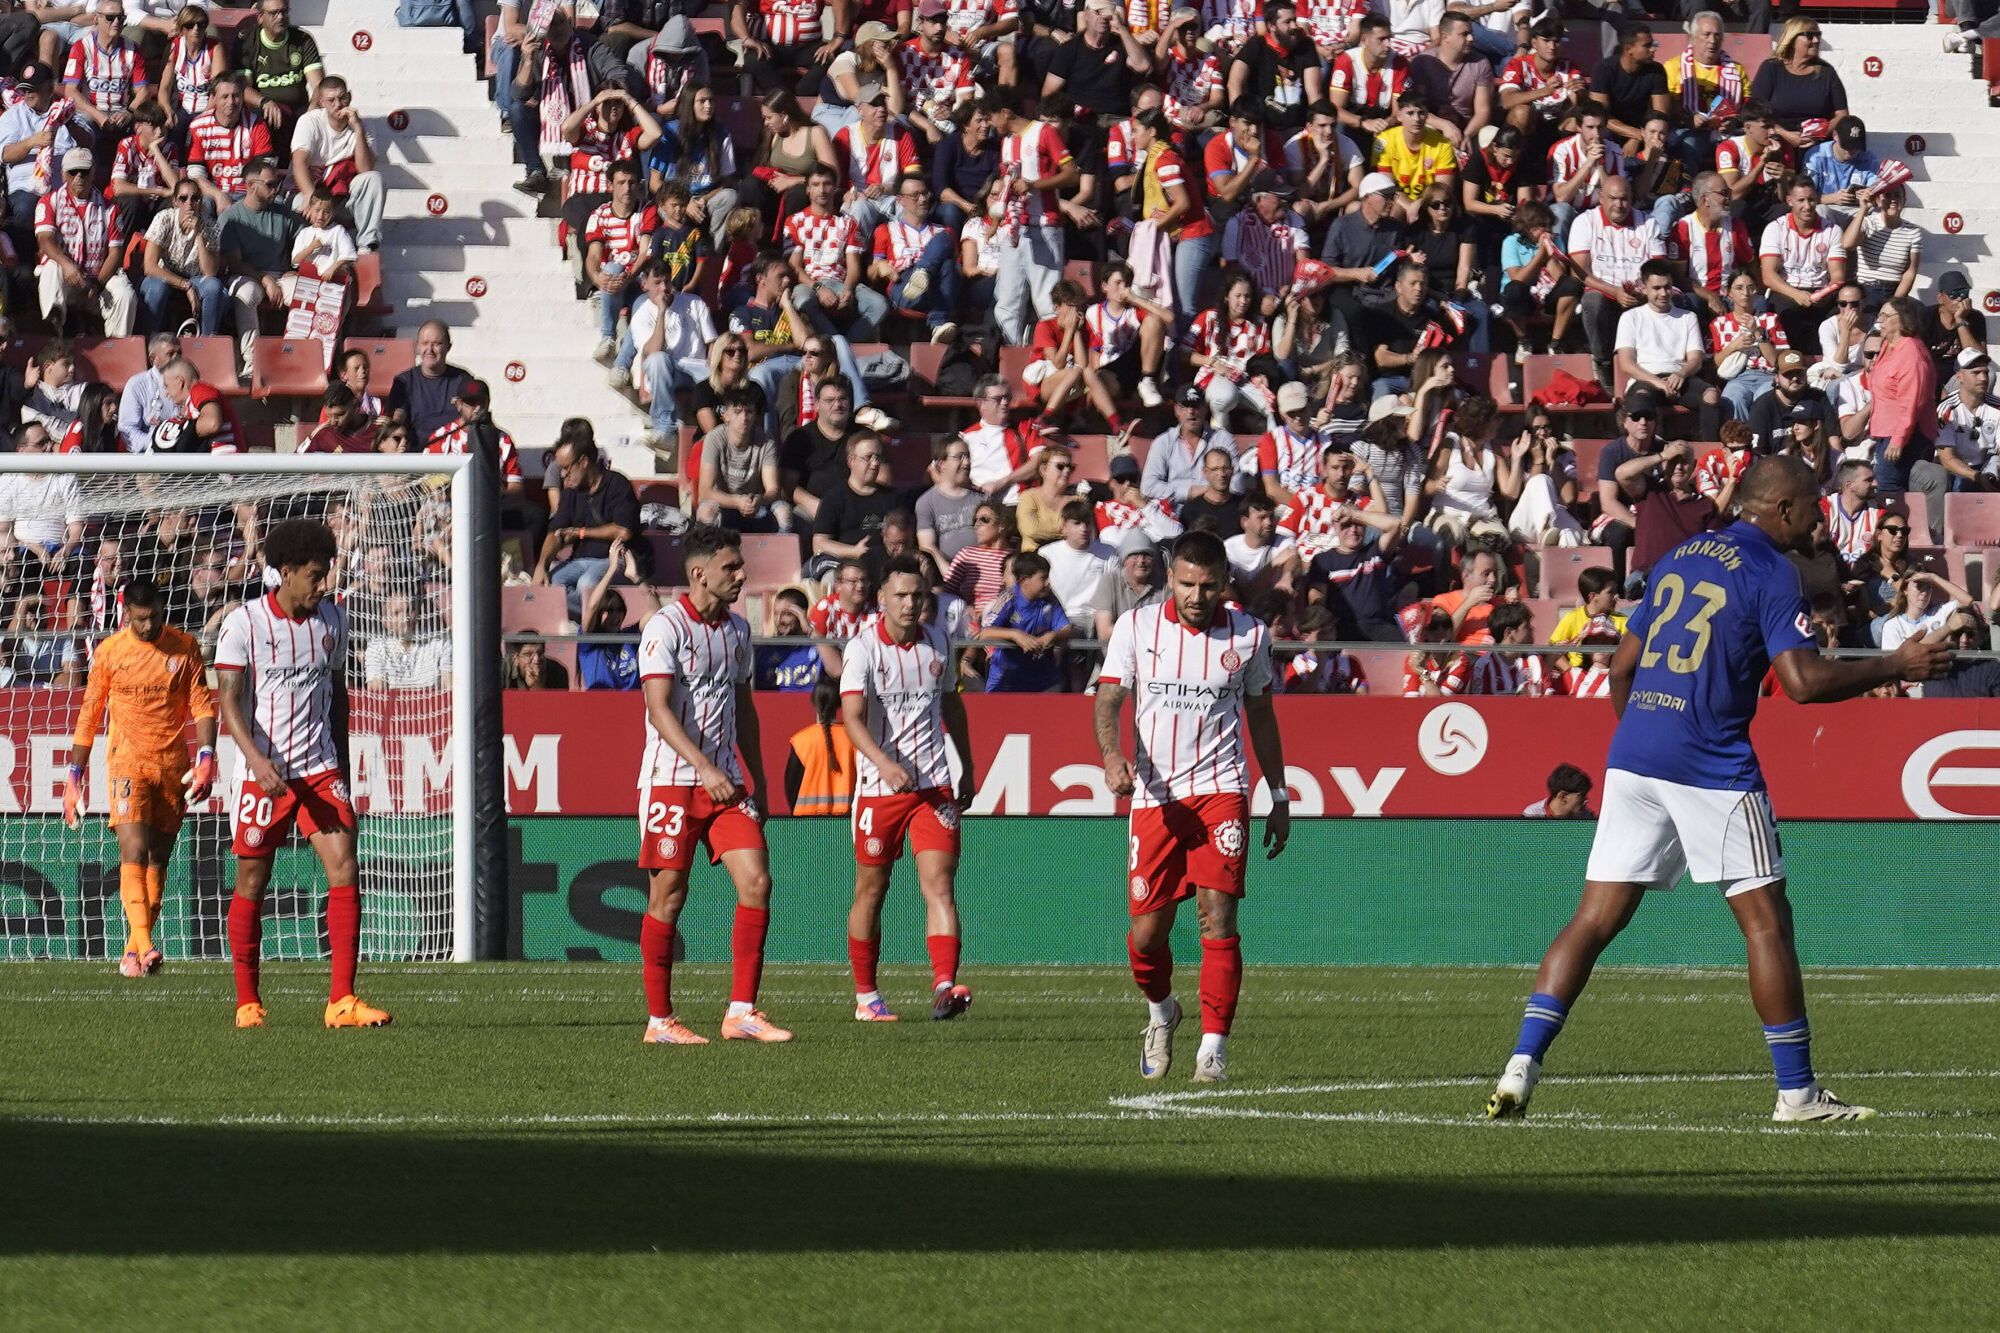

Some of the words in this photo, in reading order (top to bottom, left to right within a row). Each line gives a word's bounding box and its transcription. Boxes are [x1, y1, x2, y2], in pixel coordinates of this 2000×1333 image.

[1866, 61, 1880, 72] 12
[1911, 140, 1921, 151] 11
[1947, 217, 1960, 229] 10
[1640, 572, 1726, 674] 23
[1147, 682, 1231, 701] ETIHAD
[1162, 700, 1215, 712] AIRWAYS
[111, 777, 132, 800] 13
[239, 792, 273, 828] 20
[647, 801, 685, 837] 23
[858, 806, 875, 837] 4
